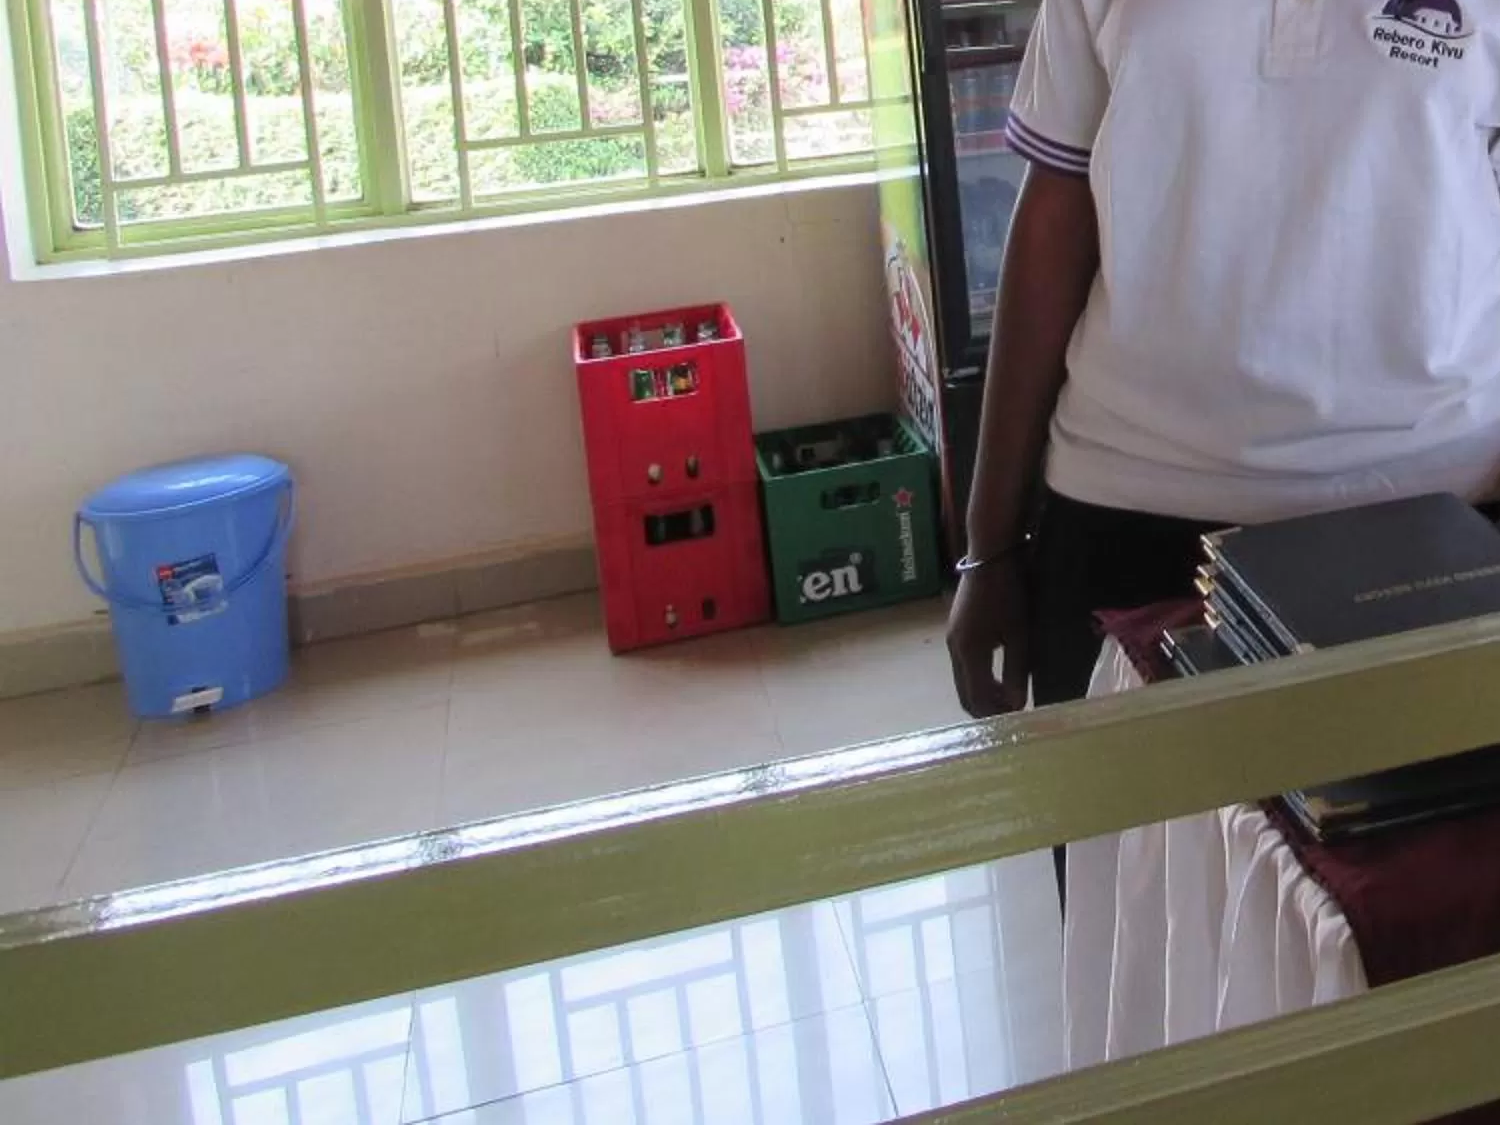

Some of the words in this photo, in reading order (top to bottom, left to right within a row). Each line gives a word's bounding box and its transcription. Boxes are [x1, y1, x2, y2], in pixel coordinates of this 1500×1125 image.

[1373, 26, 1425, 50] Rebero
[1430, 39, 1464, 60] Kivu
[1389, 45, 1440, 68] Resort
[797, 564, 864, 604] en
